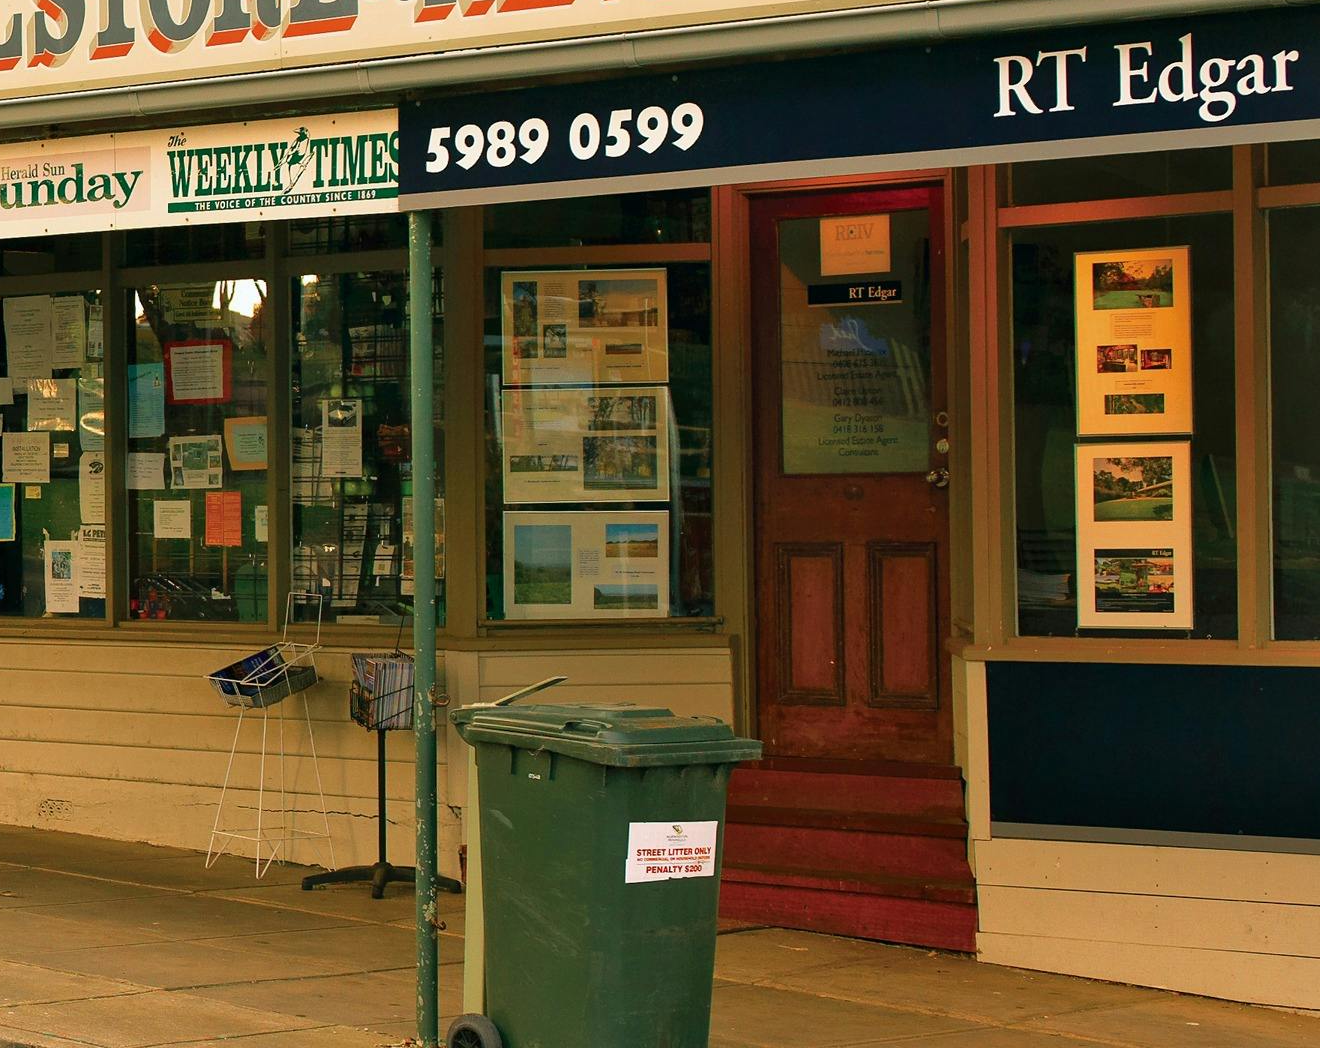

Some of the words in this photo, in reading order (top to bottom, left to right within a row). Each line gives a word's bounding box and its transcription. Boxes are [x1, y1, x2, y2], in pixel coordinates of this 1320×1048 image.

[993, 46, 1088, 119] RT
[1112, 32, 1301, 124] Edgar
[167, 132, 188, 149] The
[424, 113, 551, 174] 5989
[569, 102, 705, 161] 0599
[1, 164, 40, 182] Herald
[41, 162, 66, 179] Sun
[167, 142, 288, 198] WEEKLY
[309, 131, 399, 189] TIMES
[195, 202, 211, 211] THE
[215, 200, 241, 210] VOICE
[244, 199, 256, 208] OF
[259, 197, 277, 206] THE
[280, 194, 321, 204] COUNTRY
[325, 192, 353, 202] SINCE
[357, 189, 377, 200] 1869
[849, 287, 865, 299] RT
[868, 286, 897, 300] Edgar
[636, 849, 666, 857] STREET
[668, 848, 693, 856] LITTER
[694, 847, 711, 855] ONLY
[646, 865, 683, 874] PENALTY
[684, 865, 702, 873] $200
